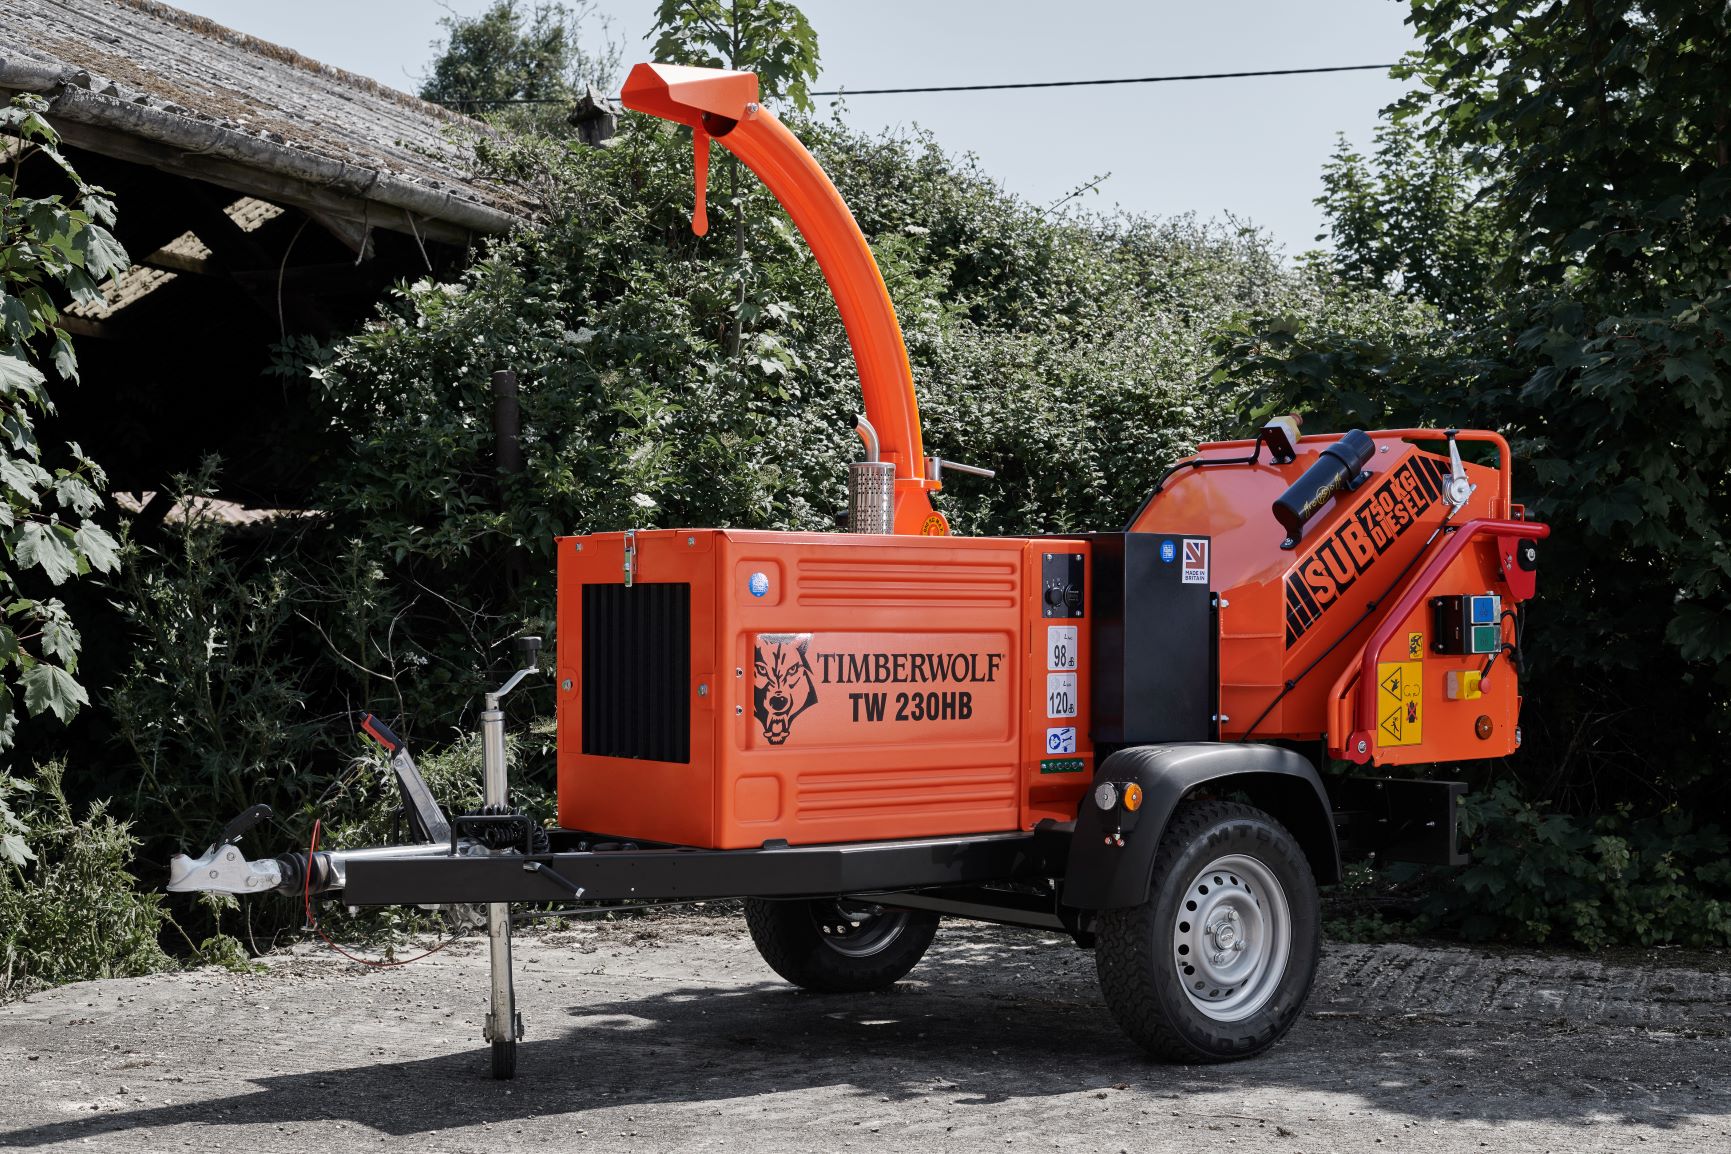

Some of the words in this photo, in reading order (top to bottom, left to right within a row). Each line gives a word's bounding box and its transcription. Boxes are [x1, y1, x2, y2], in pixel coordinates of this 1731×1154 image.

[1361, 491, 1396, 531] 750
[1390, 469, 1417, 498] KG
[1373, 488, 1429, 548] DIESEL
[1304, 518, 1375, 604] SUB
[816, 653, 1002, 684] TIMBERWOLF
[1054, 644, 1067, 667] 98
[849, 693, 887, 722] TW
[895, 691, 973, 722] 230HB
[1050, 691, 1068, 714] 120
